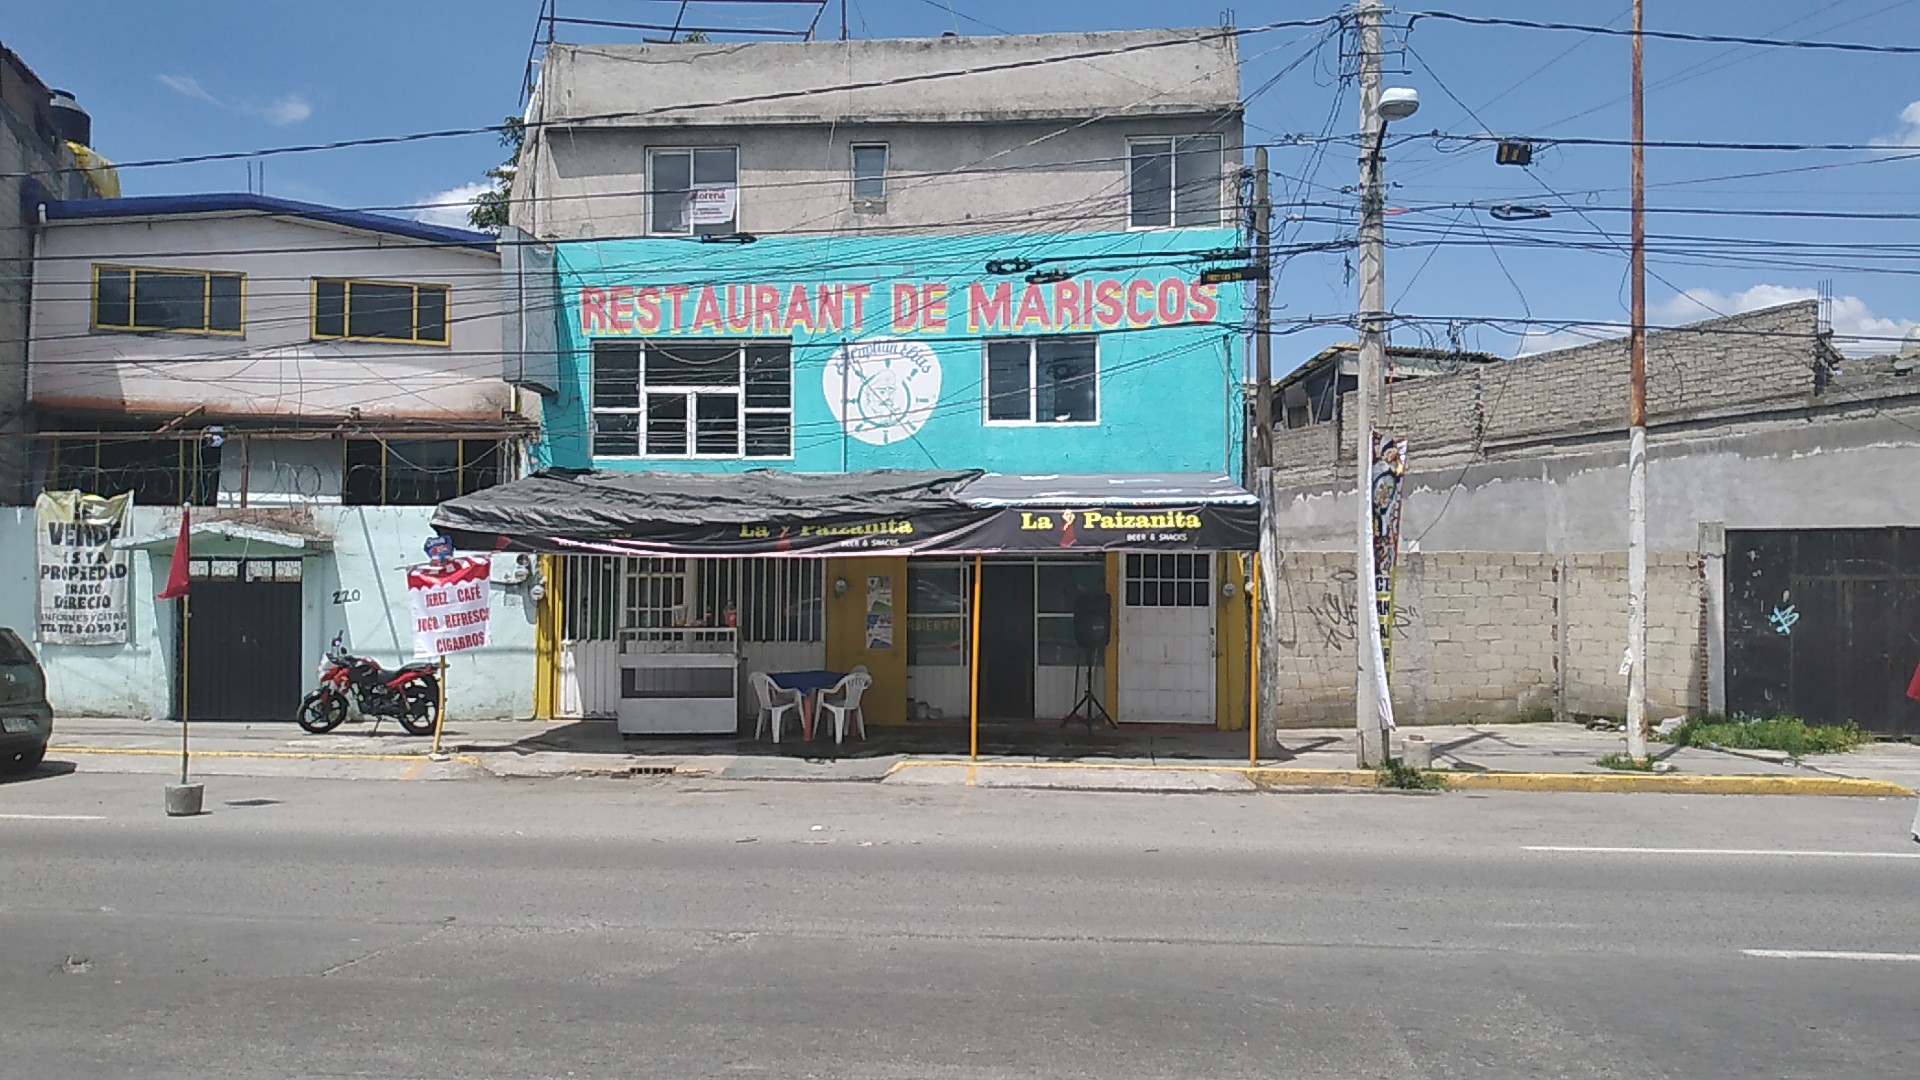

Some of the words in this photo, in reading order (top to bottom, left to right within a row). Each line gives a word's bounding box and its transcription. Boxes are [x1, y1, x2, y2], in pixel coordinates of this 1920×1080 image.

[581, 283, 870, 335] RESTAURANT
[891, 282, 948, 332] DE
[967, 277, 1218, 332] MARISCOS
[1021, 512, 1053, 530] La
[1083, 510, 1202, 530] Paizanita
[739, 525, 770, 538] La
[1127, 533, 1146, 542] BEER
[1159, 533, 1188, 542] SNACKS
[332, 589, 361, 605] 220
[457, 583, 482, 603] CAFÉ
[436, 631, 485, 653] CIGARROS
